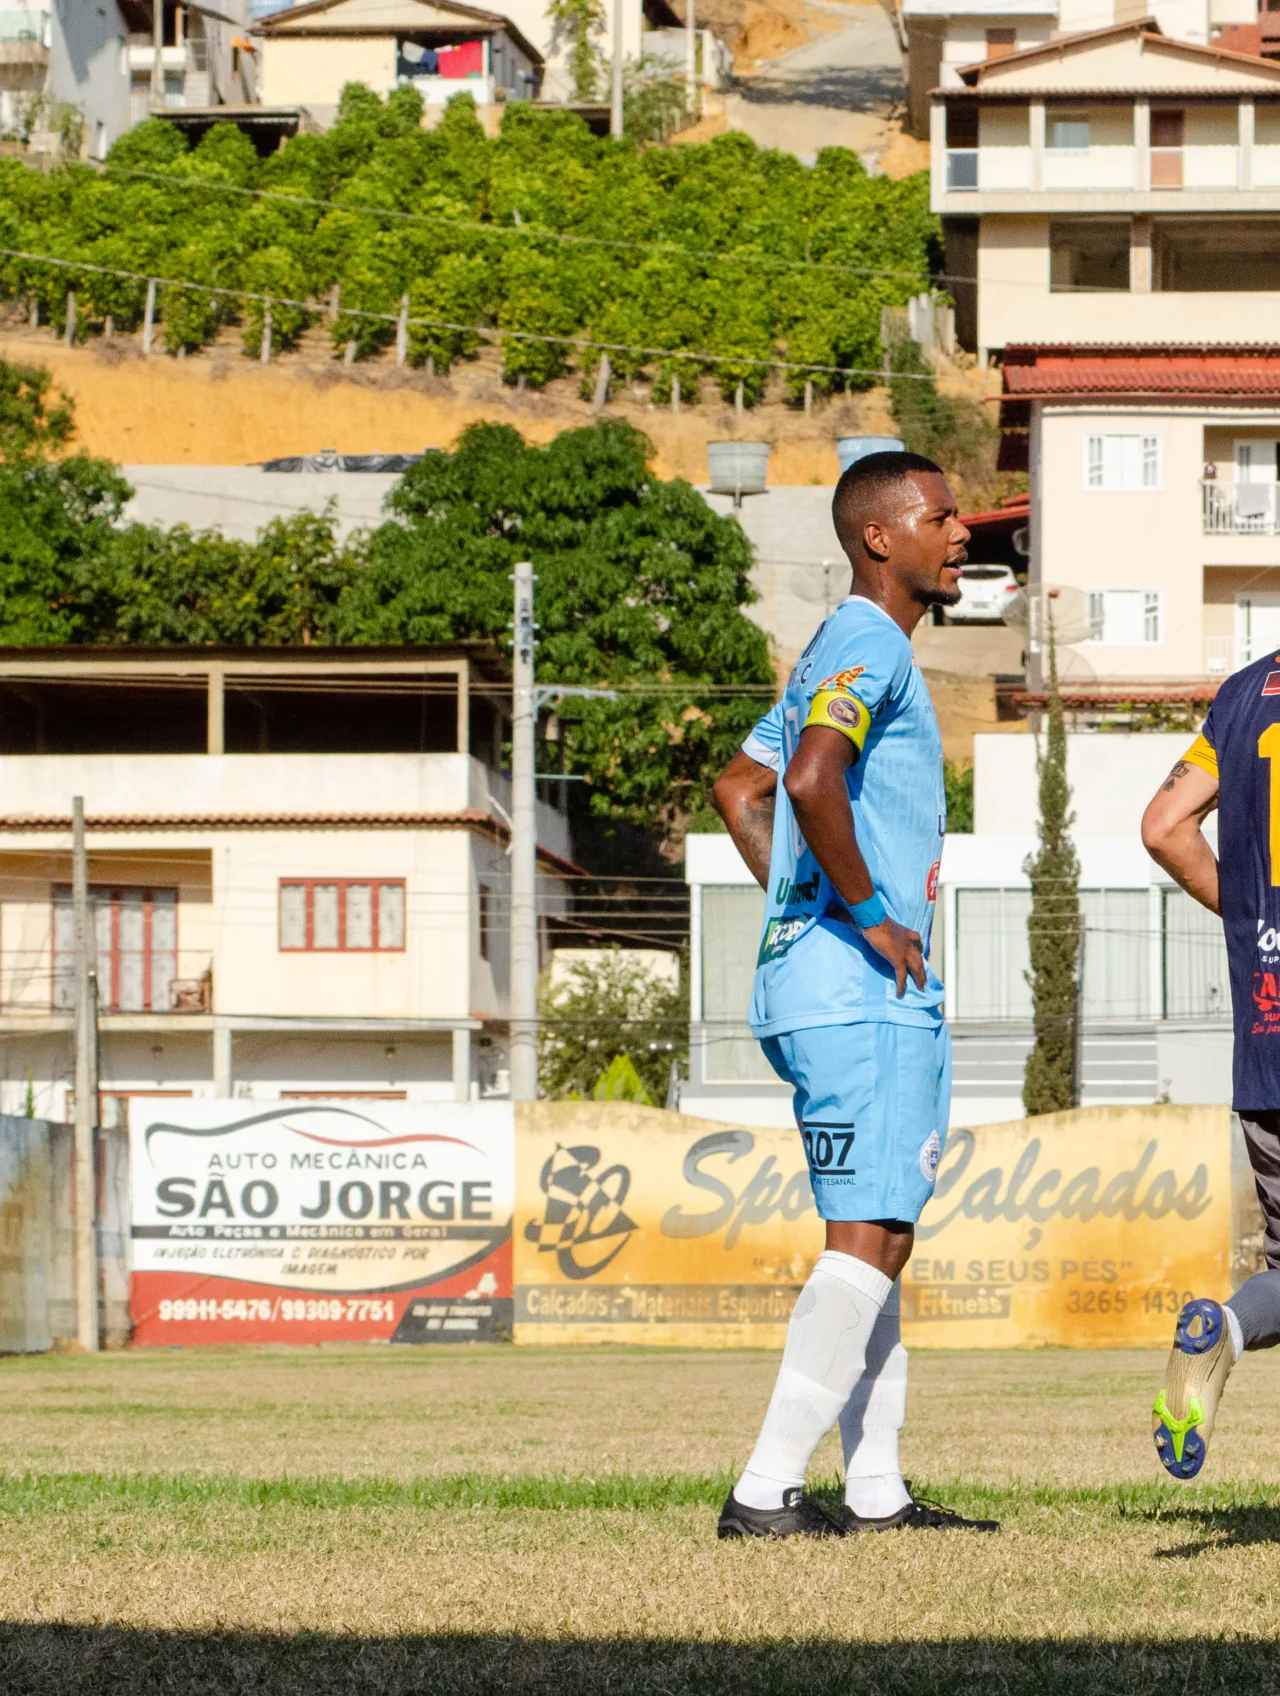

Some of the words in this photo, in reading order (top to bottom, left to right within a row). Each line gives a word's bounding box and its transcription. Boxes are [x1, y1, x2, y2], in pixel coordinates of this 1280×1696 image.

[207, 1154, 278, 1170] AUTO
[289, 1149, 428, 1170] MECÂNICA
[155, 1172, 280, 1220] SÃO
[299, 1179, 494, 1221] JORGE
[660, 1129, 818, 1251] Spo
[914, 1129, 1213, 1251] Calçados
[168, 1225, 206, 1237] Auto
[370, 1228, 395, 1238] em
[402, 1225, 448, 1238] Geral
[912, 1258, 955, 1281] EM
[966, 1258, 1050, 1282] SEUS
[719, 1289, 797, 1320] Esportiv
[917, 1288, 1003, 1317] Fitness
